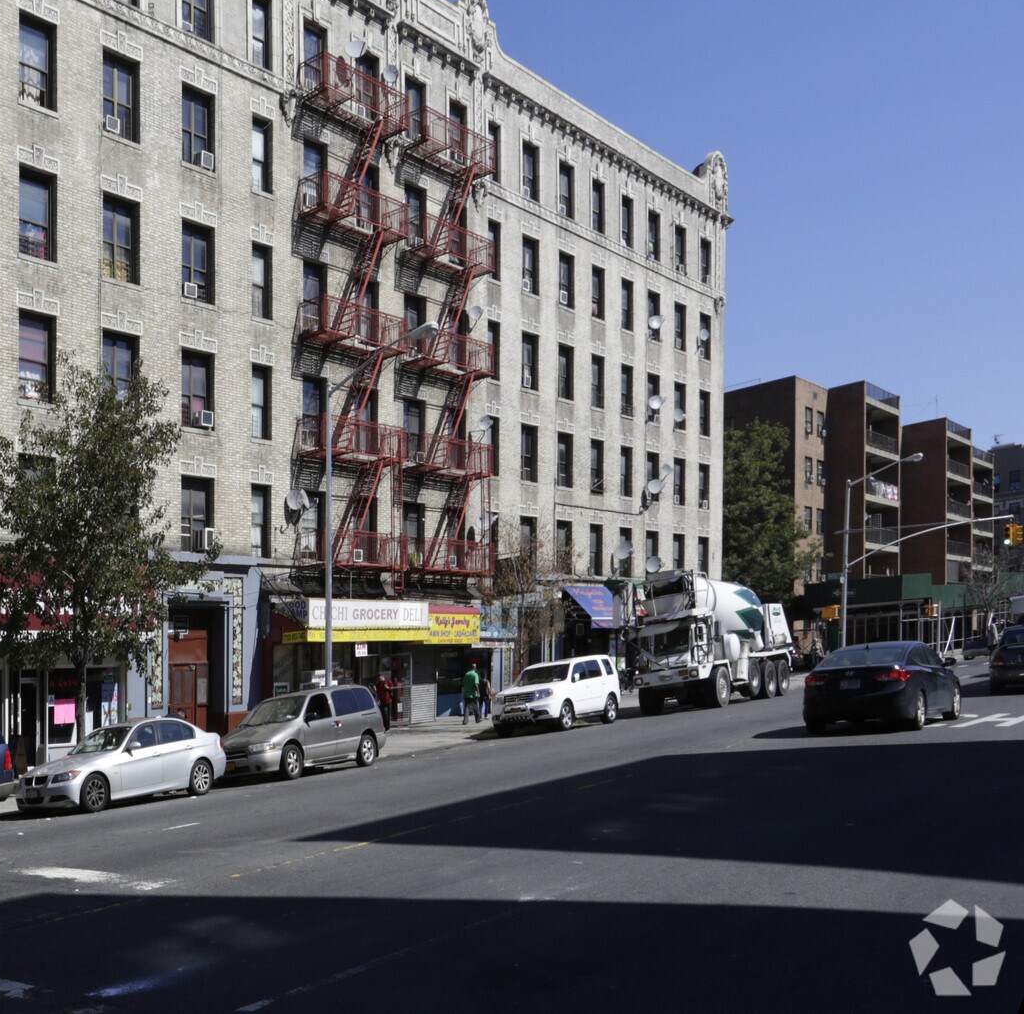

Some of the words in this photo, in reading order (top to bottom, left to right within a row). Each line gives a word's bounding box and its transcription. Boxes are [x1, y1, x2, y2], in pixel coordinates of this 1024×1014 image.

[312, 605, 348, 621] CHCHI
[352, 608, 399, 620] GROCERY
[403, 608, 423, 622] DELI
